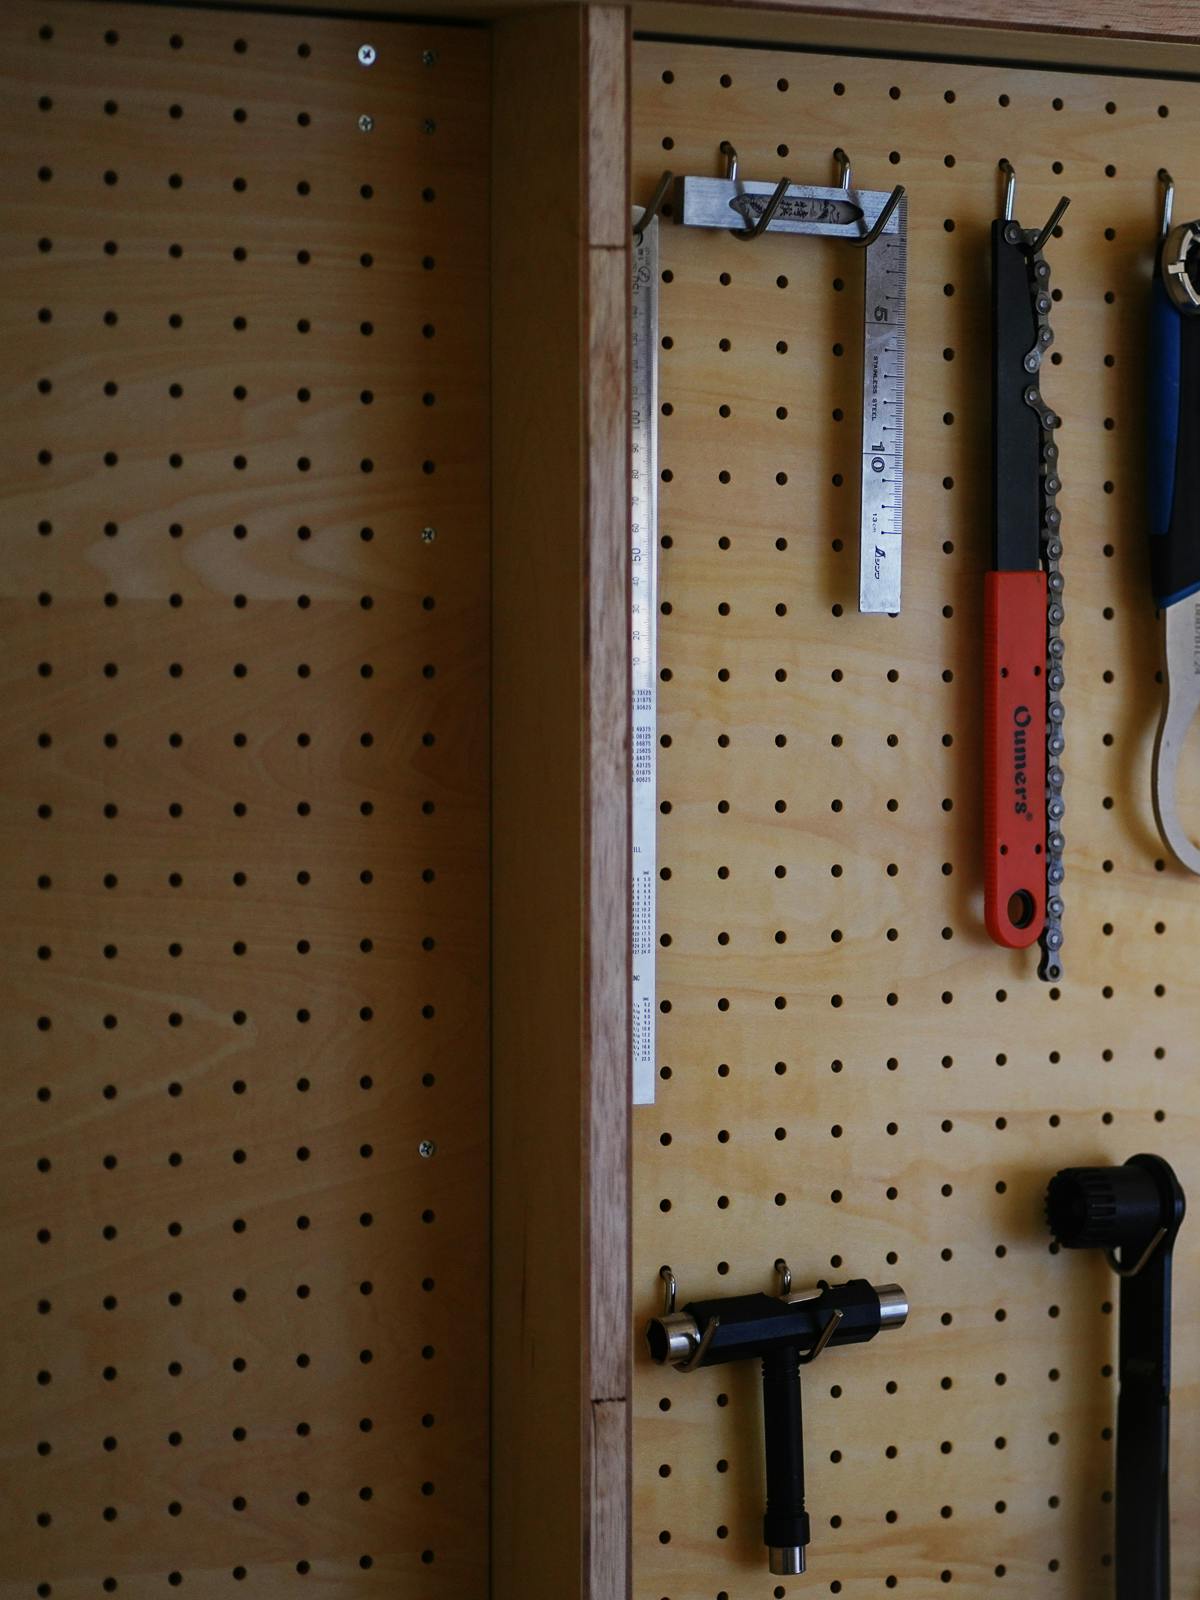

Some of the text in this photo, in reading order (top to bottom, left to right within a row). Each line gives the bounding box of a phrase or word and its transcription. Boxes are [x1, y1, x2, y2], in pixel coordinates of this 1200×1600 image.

[874, 305, 888, 321] 5
[871, 441, 885, 473] 10
[632, 547, 641, 562] 50
